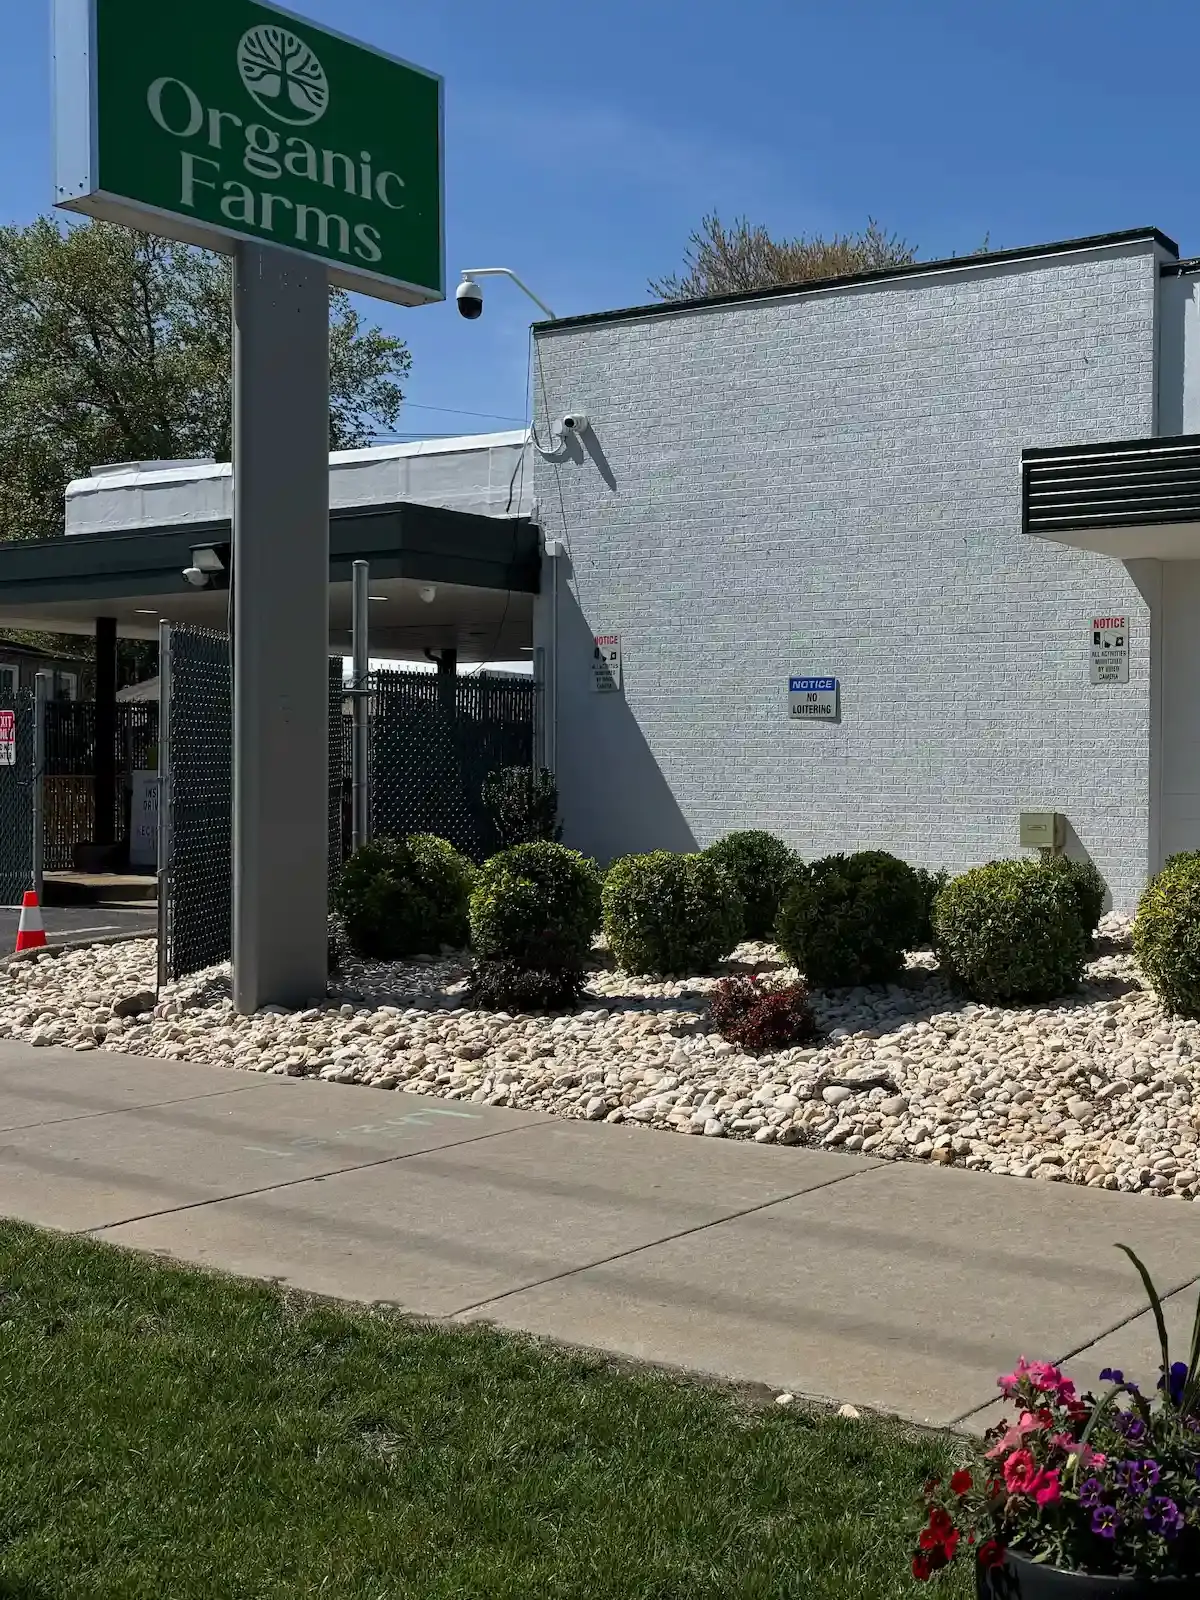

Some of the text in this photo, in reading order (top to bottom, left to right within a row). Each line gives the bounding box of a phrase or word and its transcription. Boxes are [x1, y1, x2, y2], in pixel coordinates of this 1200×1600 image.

[146, 76, 406, 210] Organic
[179, 150, 383, 262] Farms
[1093, 617, 1125, 628] NOTICE
[594, 635, 618, 645] NOTICE
[792, 680, 832, 689] NOTICE
[807, 692, 818, 702] NO
[792, 704, 831, 714] LOITERING
[0, 715, 12, 728] XIT
